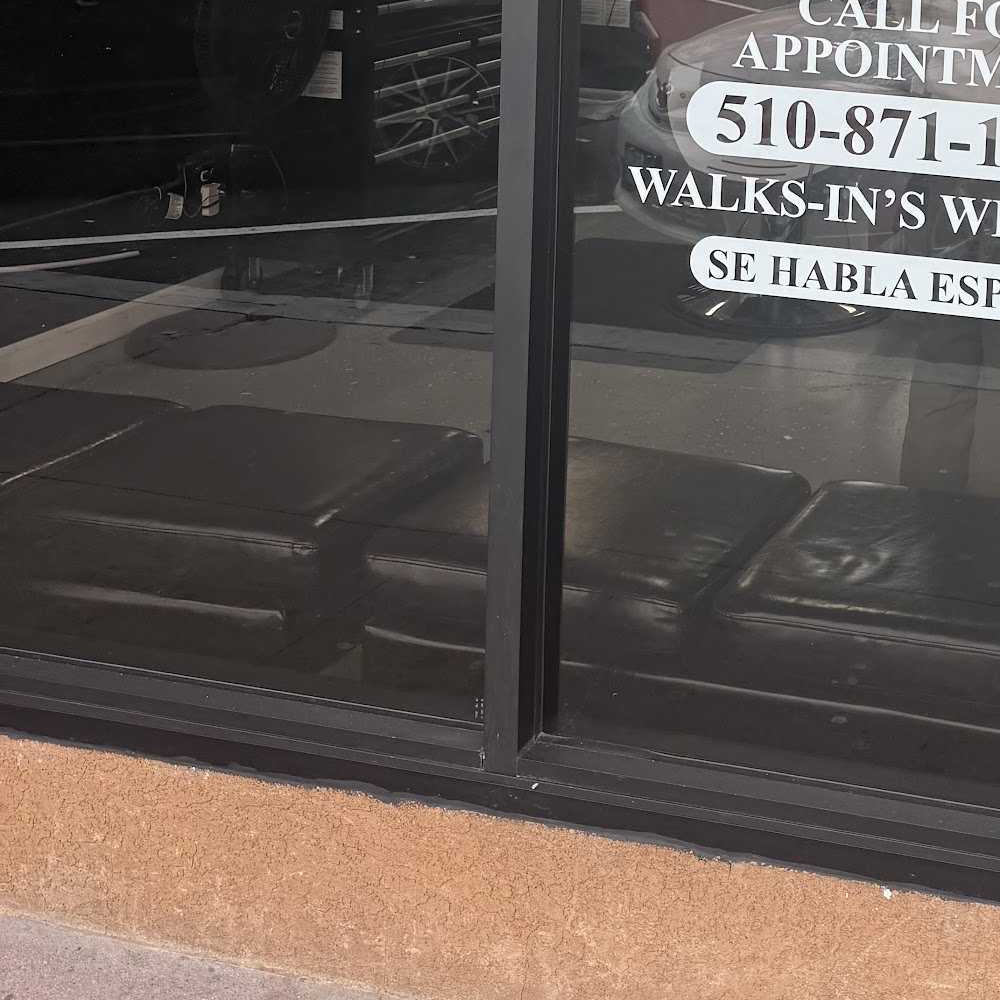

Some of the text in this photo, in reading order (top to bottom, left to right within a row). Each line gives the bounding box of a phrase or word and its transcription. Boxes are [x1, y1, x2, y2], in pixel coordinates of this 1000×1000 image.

[627, 166, 926, 230] WALKS-IN’S
[708, 249, 757, 283] SE
[770, 255, 918, 301] HABLA
